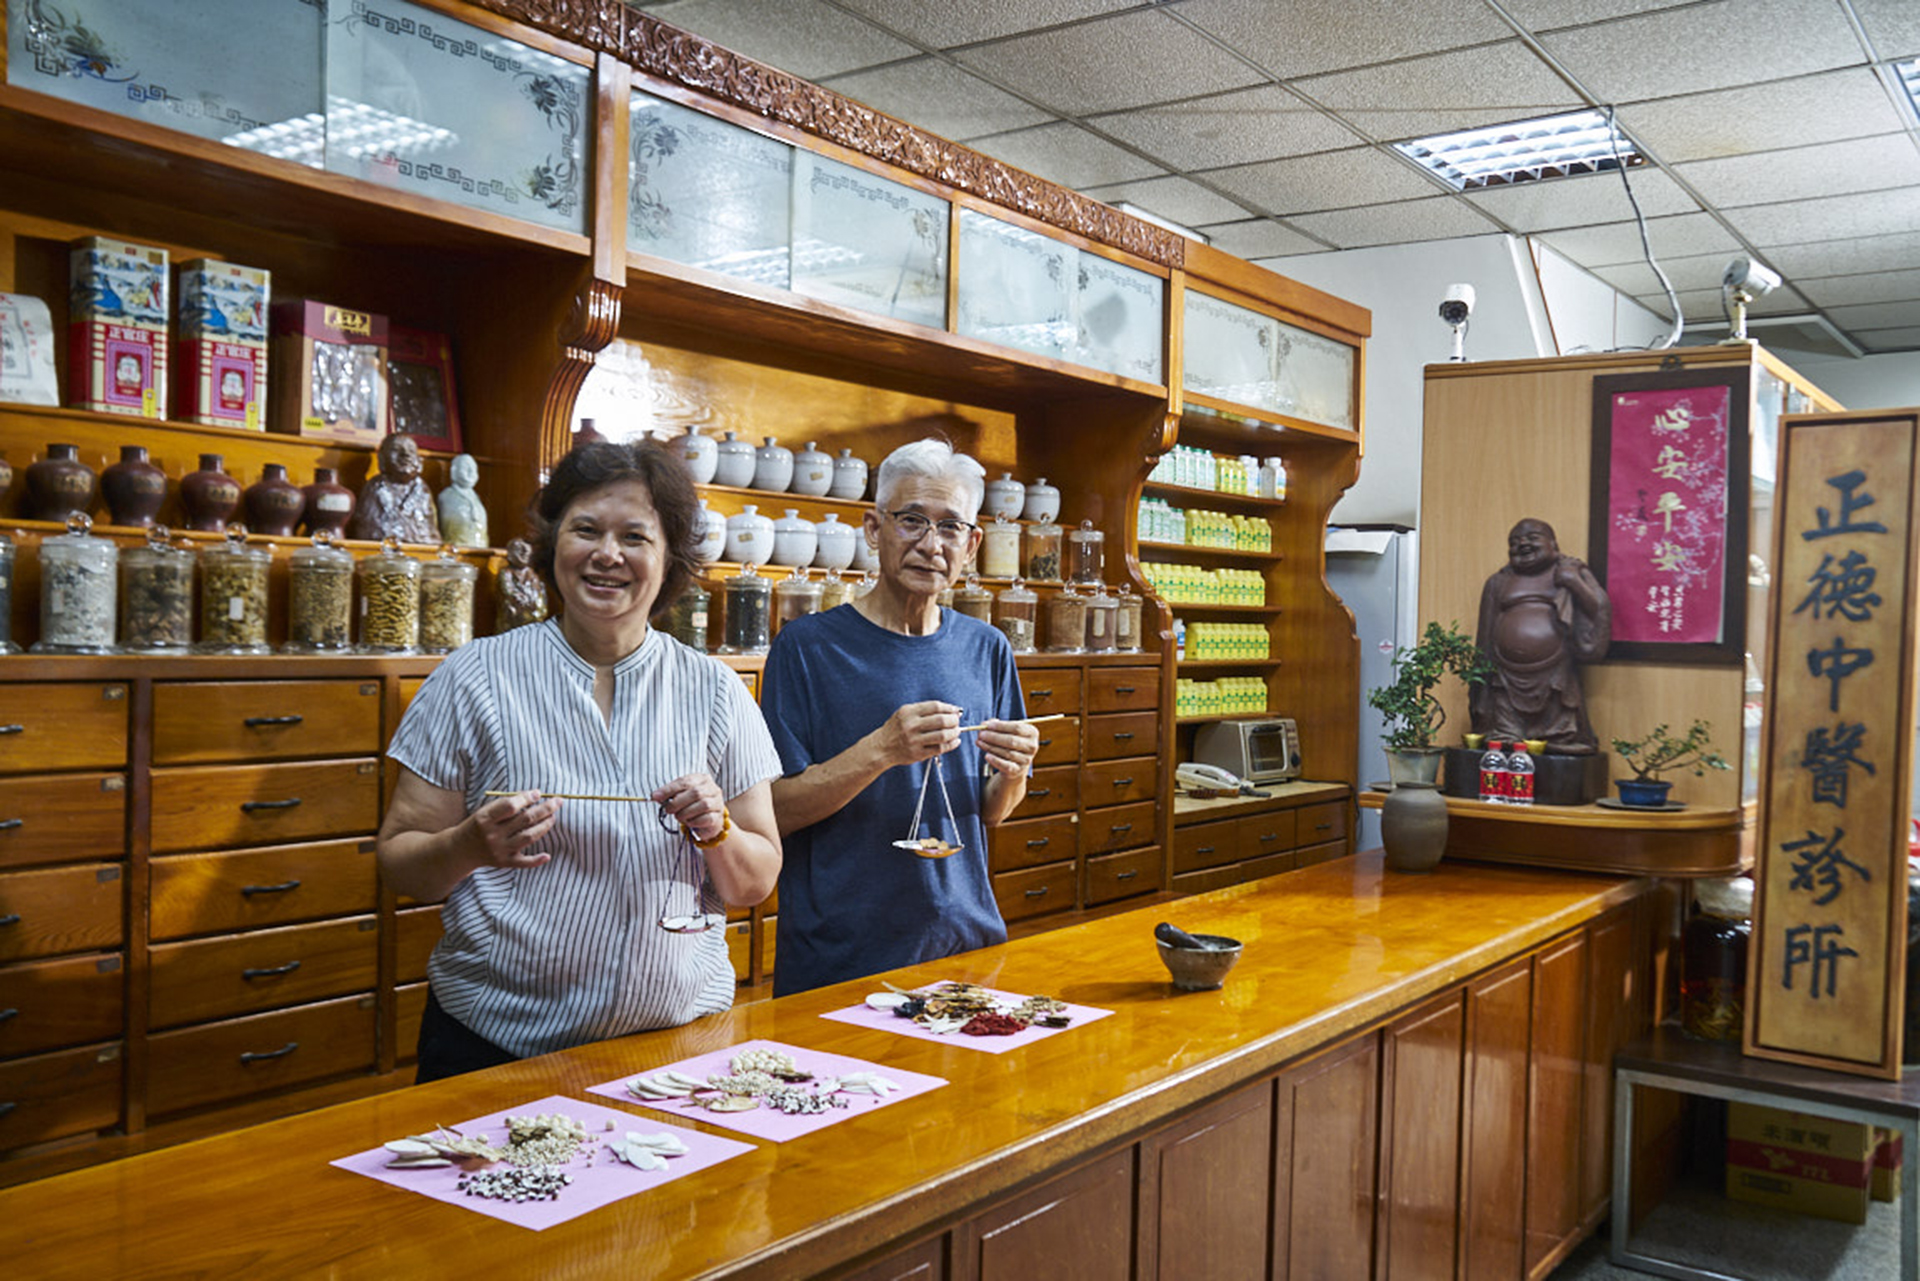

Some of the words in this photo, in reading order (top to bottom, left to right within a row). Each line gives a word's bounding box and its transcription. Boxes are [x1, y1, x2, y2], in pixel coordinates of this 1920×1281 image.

[1651, 407, 1690, 572] 心安平安
[1781, 469, 1888, 999] 正德中醫診所
